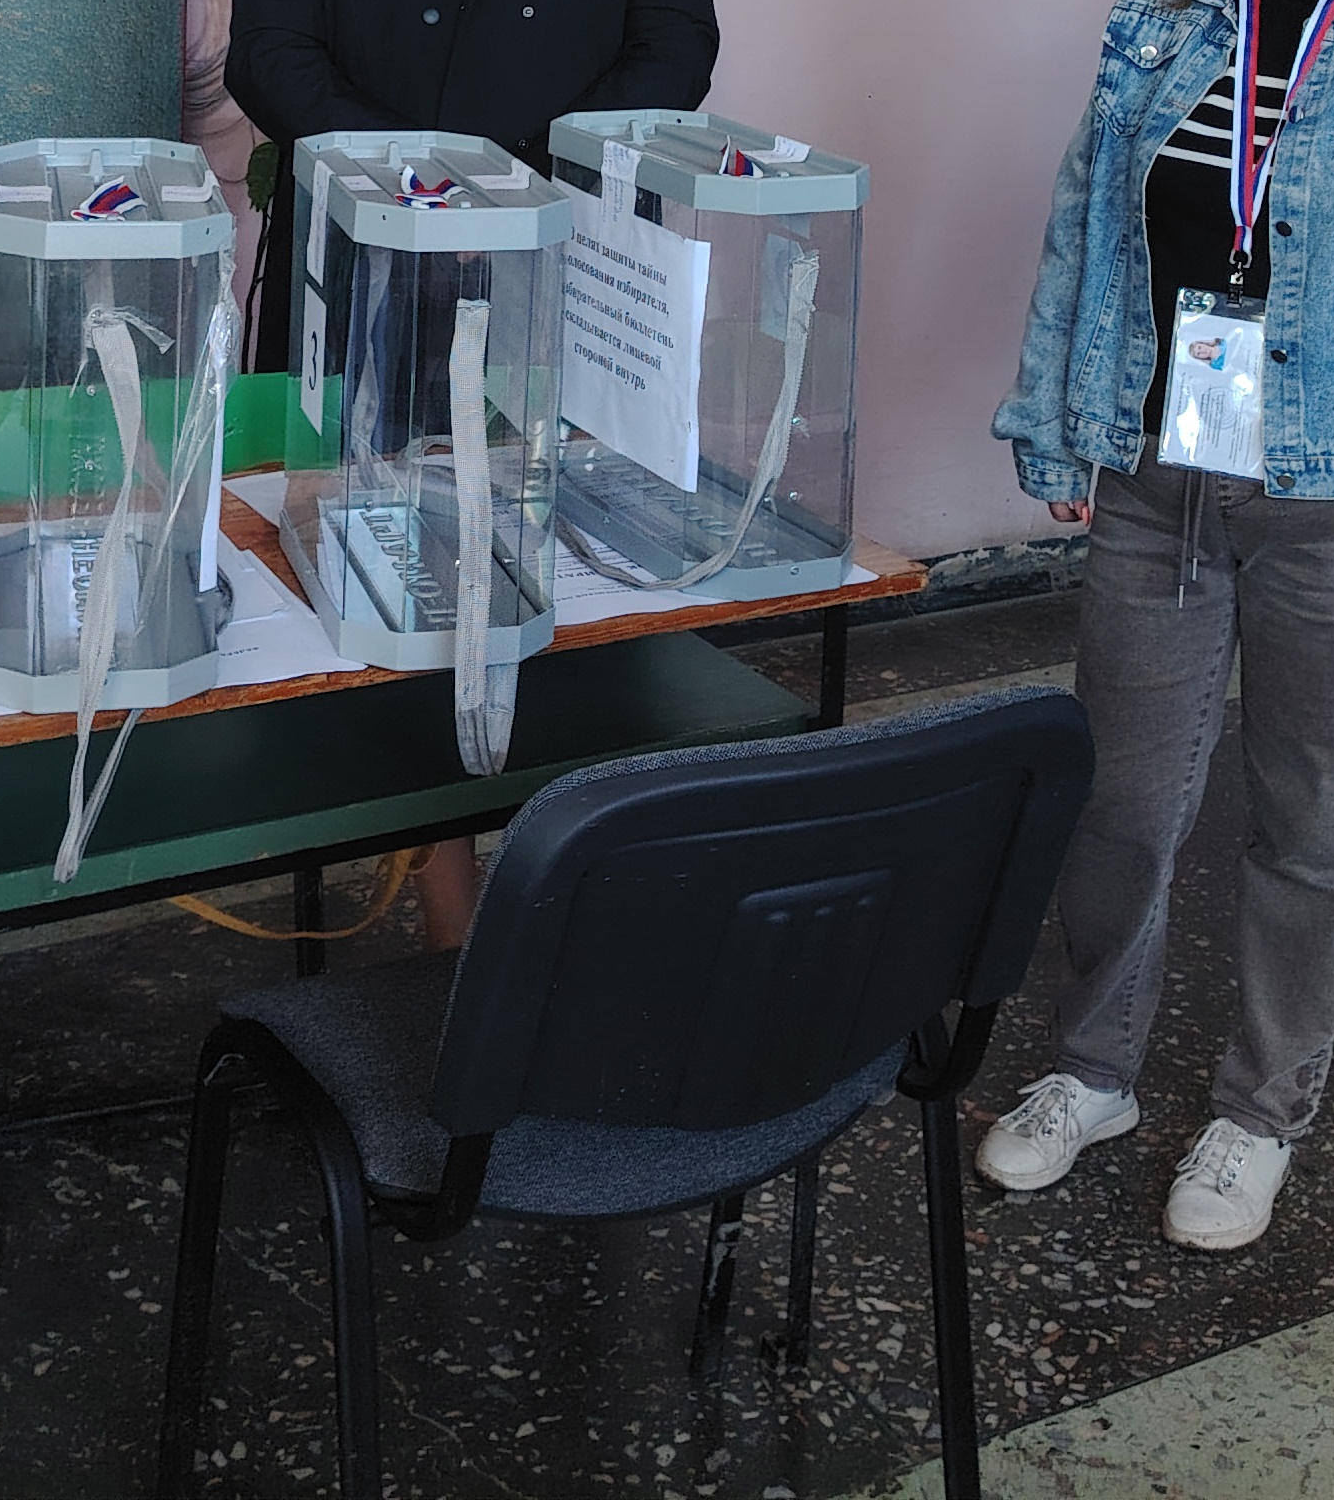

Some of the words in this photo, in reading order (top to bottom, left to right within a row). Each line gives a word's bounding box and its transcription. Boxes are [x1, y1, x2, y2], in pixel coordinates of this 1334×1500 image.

[567, 254, 615, 288] олосования
[637, 262, 668, 287] тайны
[624, 311, 674, 350] бюллетень
[574, 341, 614, 373] стороной
[615, 363, 647, 392] внутрь
[622, 342, 662, 372] лицевой
